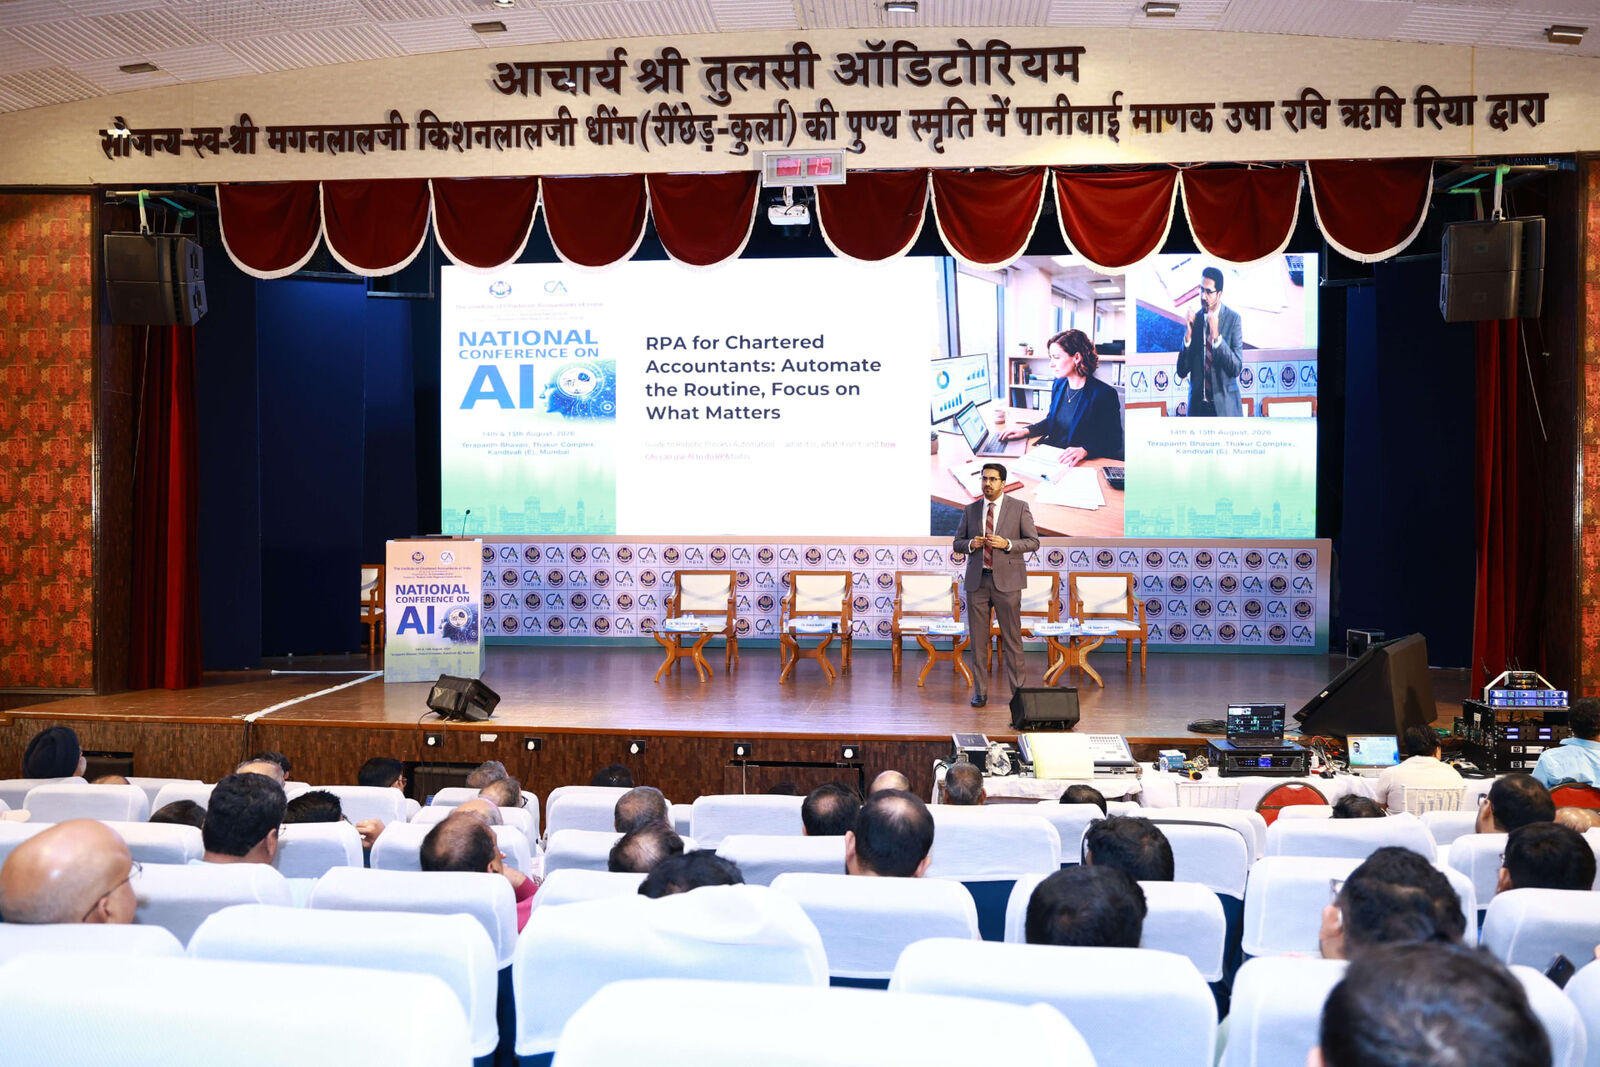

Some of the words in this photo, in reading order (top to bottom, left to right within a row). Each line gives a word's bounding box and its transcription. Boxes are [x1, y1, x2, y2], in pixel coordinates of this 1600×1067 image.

[493, 47, 627, 96] आचार्य
[637, 47, 689, 94] श्री
[701, 42, 821, 107] तुलसी
[834, 39, 1085, 88] ऑडिटोरियम
[266, 110, 409, 155] मगनलालजी
[417, 105, 577, 153] किशनलालजी
[803, 98, 840, 141] की
[847, 110, 902, 154] पुण्य
[909, 97, 977, 154] स्मृति
[985, 94, 1011, 137] में
[1016, 91, 1123, 142] पानीबाई
[1129, 103, 1215, 134] माणक
[1223, 101, 1275, 134] उषा
[1282, 88, 1331, 133] रवि
[1338, 86, 1406, 131] ऋषि
[1413, 85, 1477, 131] रिया
[1486, 93, 1549, 132] द्वारा
[544, 281, 568, 293] CA
[459, 329, 599, 347] NATIONAL
[645, 336, 687, 350] RPA
[692, 335, 720, 350] for
[725, 334, 825, 350] Chartered
[458, 349, 568, 360] CONFERENCE
[574, 347, 600, 358] ON
[645, 358, 776, 374] Accountants:
[781, 357, 882, 373] Automate
[1131, 371, 1149, 388] CA
[1258, 367, 1276, 384] CA
[1300, 365, 1318, 382] CA
[459, 364, 534, 410] AI
[645, 382, 678, 397] the
[683, 381, 766, 399] Routine,
[771, 382, 830, 397] Focus
[835, 384, 861, 397] on
[645, 405, 700, 420] What
[705, 404, 781, 420] Matters
[440, 552, 454, 561] CA
[500, 547, 518, 559] CA
[546, 547, 564, 559] CA
[592, 547, 610, 560] CA
[638, 548, 656, 560] CA
[685, 548, 703, 560] CA
[732, 548, 750, 560] CA
[779, 548, 798, 561] CA
[827, 548, 846, 561] CA
[875, 549, 894, 561] CA
[924, 549, 942, 562] CA
[1070, 551, 1089, 563] CA
[1119, 551, 1139, 563] CA
[1169, 552, 1189, 564] CA
[1219, 552, 1238, 564] CA
[1268, 552, 1288, 565] CA
[523, 570, 541, 583] CA
[569, 570, 587, 583] CA
[615, 571, 633, 583] CA
[756, 572, 775, 584] CA
[1144, 576, 1163, 588] CA
[1193, 576, 1213, 588] CA
[1243, 577, 1263, 589] CA
[1293, 577, 1312, 589] CA
[395, 583, 470, 596] NATIONAL
[395, 596, 454, 604] CONFERENCE
[456, 595, 470, 603] ON
[501, 594, 519, 606] CA
[546, 594, 564, 606] CA
[592, 594, 610, 606] CA
[638, 594, 657, 607] CA
[1168, 600, 1188, 613] CA
[1217, 600, 1237, 613] CA
[1267, 601, 1287, 614] CA
[396, 605, 435, 635] AI
[524, 617, 541, 629] CA
[569, 617, 587, 629] CA
[616, 617, 633, 630] CA
[756, 619, 775, 631] CA
[1192, 624, 1212, 637] CA
[1242, 625, 1261, 637] CA
[1292, 626, 1312, 638] CA
